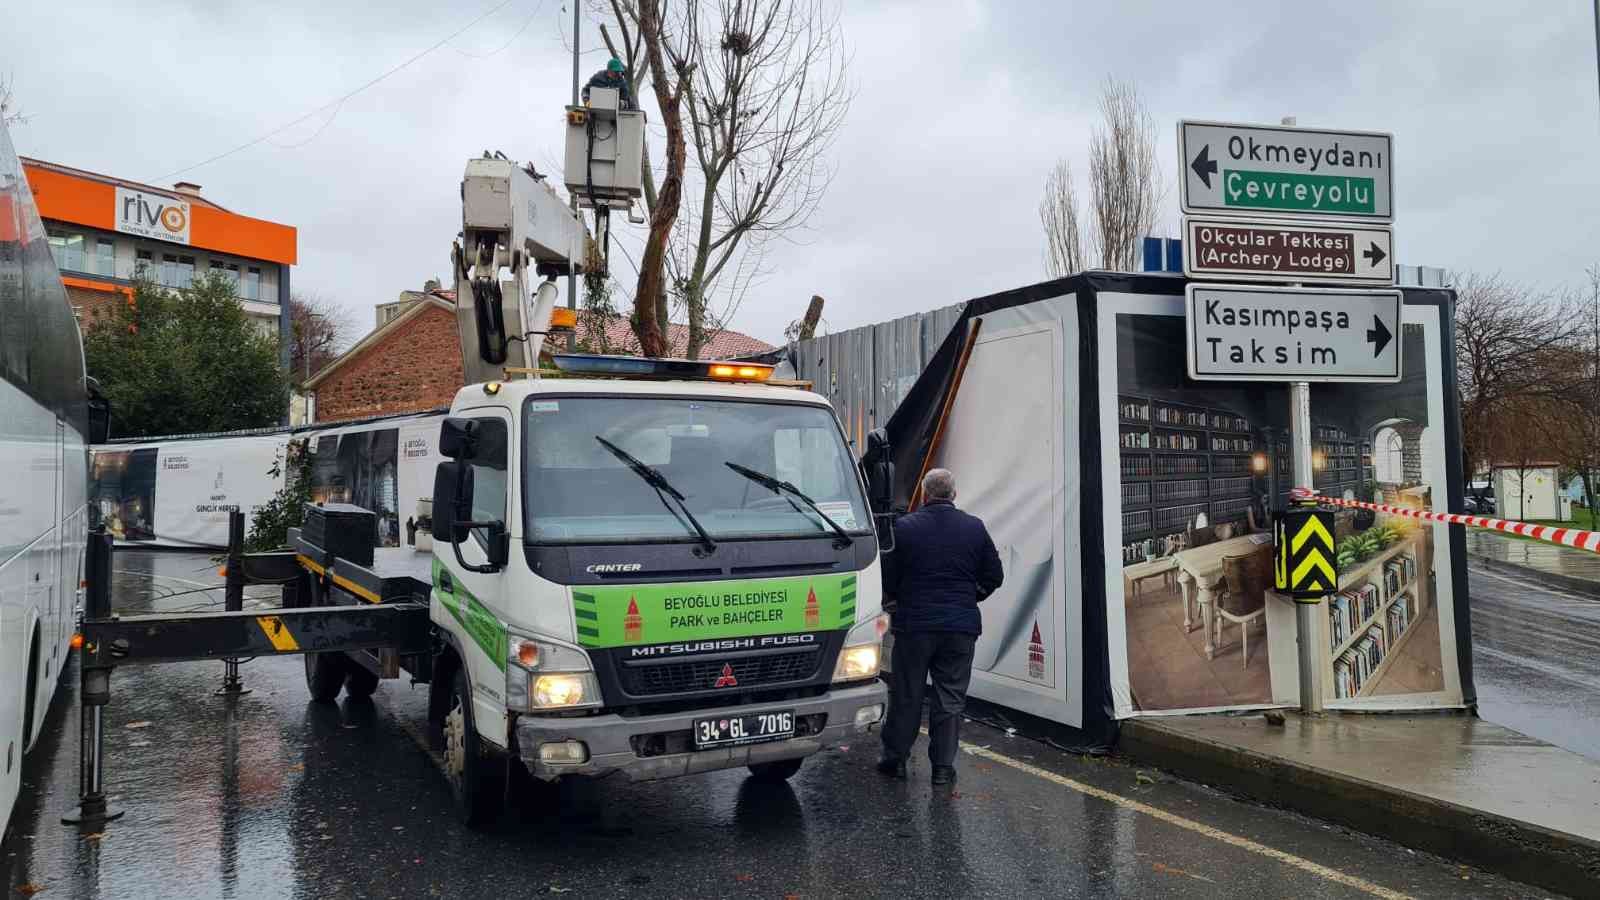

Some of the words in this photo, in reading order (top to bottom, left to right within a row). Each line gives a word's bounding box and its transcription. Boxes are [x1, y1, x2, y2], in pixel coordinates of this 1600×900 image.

[1228, 136, 1382, 171] Okmeydanı
[1227, 173, 1369, 208] Çevreyolu
[1200, 229, 1276, 248] Okçular
[1280, 232, 1349, 250] Tekkesi
[1200, 248, 1283, 270] (Archery
[1289, 251, 1351, 272] Lodge)
[1205, 299, 1350, 334] Kasımpaşa
[1206, 337, 1337, 364] Taksim
[586, 563, 642, 574] CANTER
[664, 594, 720, 611] BEYOĞLU
[723, 588, 788, 607] BELEDİYESİ
[670, 614, 704, 629] PARK
[706, 616, 720, 626] ve
[723, 609, 784, 626] BAHÇELER
[631, 638, 755, 657] MITSUBISHI
[761, 633, 815, 647] FUSO
[700, 721, 720, 741] 34
[730, 718, 749, 738] GL
[758, 712, 791, 734] 7016
